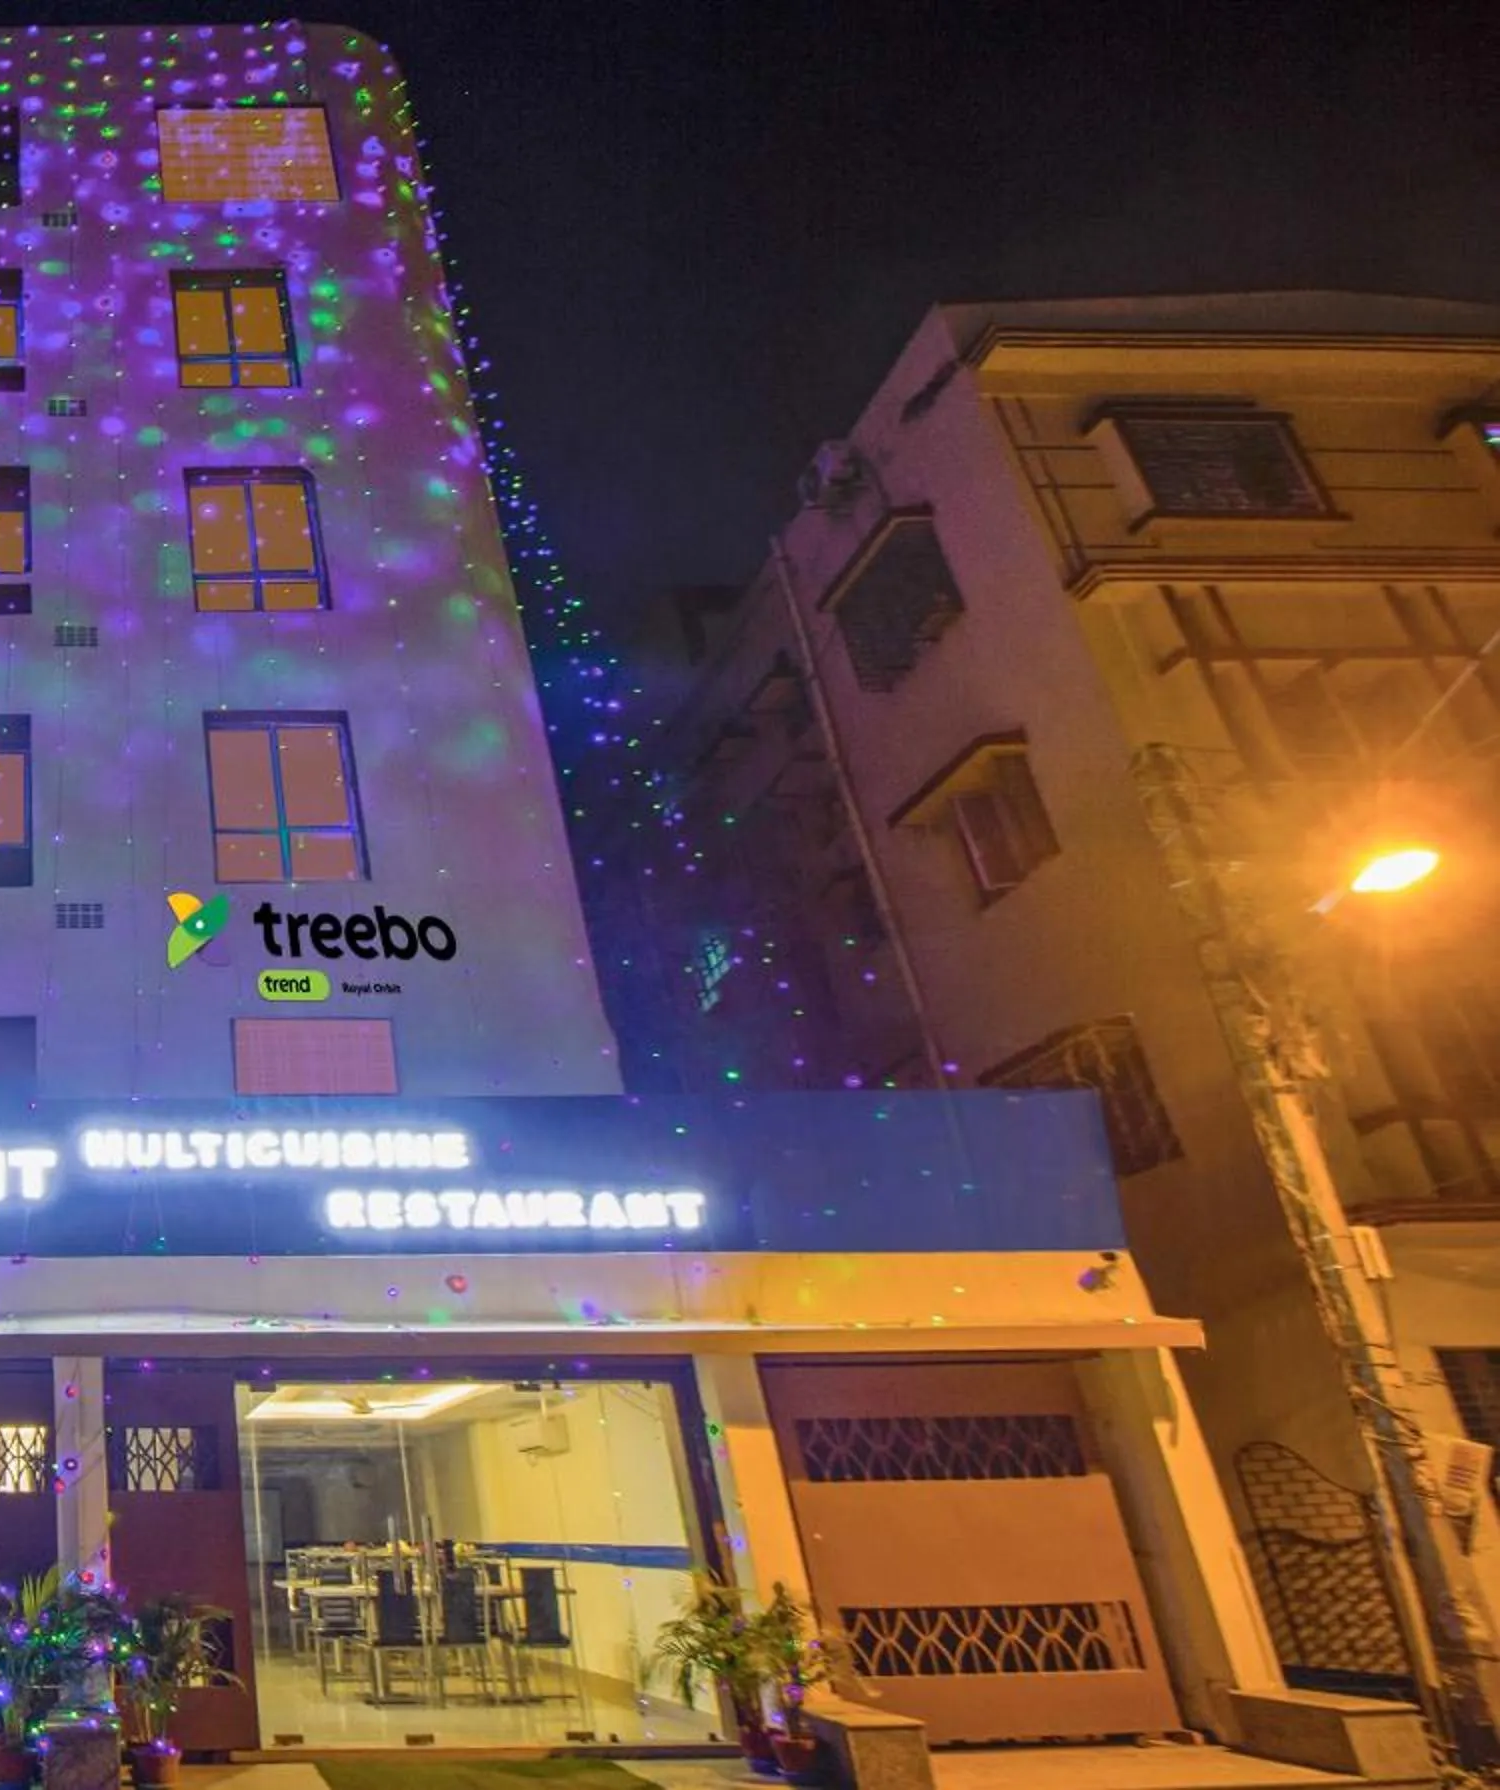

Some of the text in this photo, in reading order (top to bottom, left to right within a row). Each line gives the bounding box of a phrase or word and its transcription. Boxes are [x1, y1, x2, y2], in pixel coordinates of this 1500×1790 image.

[253, 902, 457, 960] treebo
[264, 975, 311, 993] trend
[81, 1129, 469, 1170] MULTICUISINE
[325, 1189, 704, 1229] RESTAURANT
